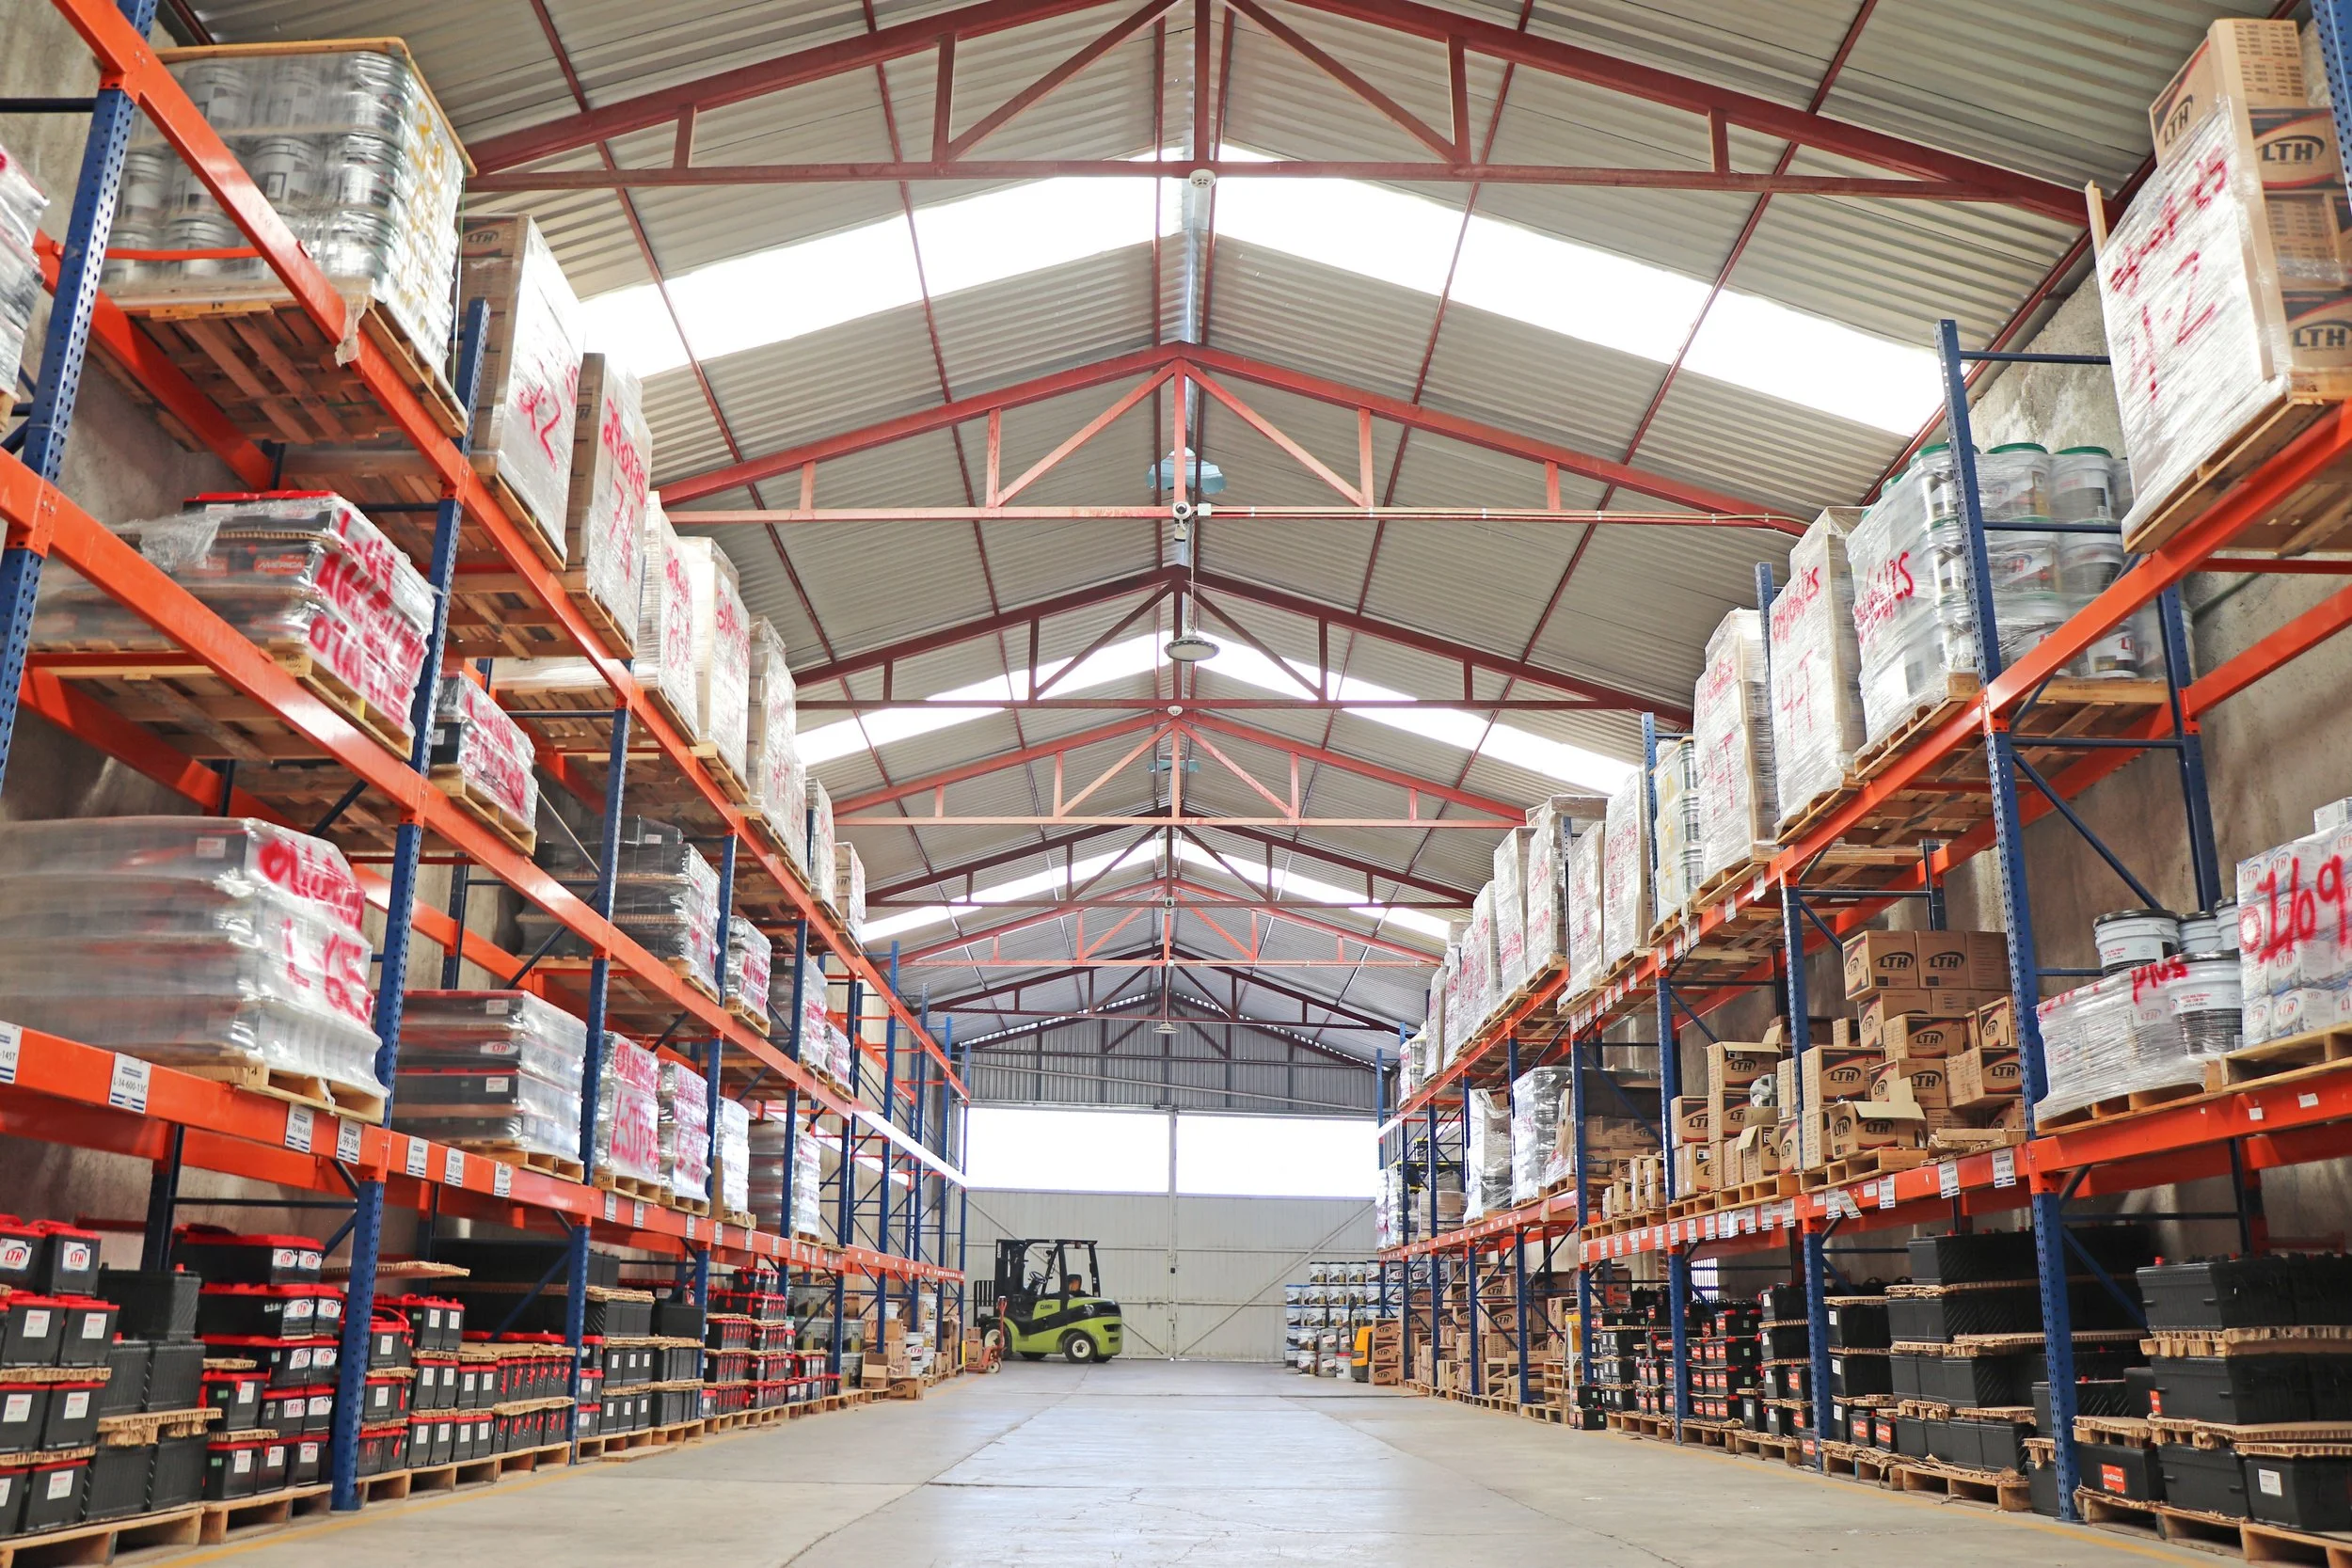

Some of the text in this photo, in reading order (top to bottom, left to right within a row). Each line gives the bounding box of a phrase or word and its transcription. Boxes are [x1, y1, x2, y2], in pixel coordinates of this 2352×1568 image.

[2164, 105, 2189, 146] LTH
[2262, 142, 2313, 161] LTH
[467, 234, 493, 244] LTH
[2292, 328, 2345, 347] LTH
[2270, 856, 2287, 870] LTH
[2243, 867, 2258, 882] LTH
[1880, 957, 1908, 968] LTH
[1930, 957, 1958, 968] LTH
[2276, 952, 2294, 968] LTH
[1847, 961, 1857, 975] LTH
[2140, 1010, 2159, 1021] LTH
[2249, 1008, 2264, 1022] LTH
[2278, 1002, 2295, 1016] LTH
[1862, 1019, 1872, 1033] LTH
[1985, 1023, 1996, 1037] LTH
[1915, 1034, 1940, 1044] LTH
[492, 1044, 509, 1053] LTH
[1731, 1060, 1753, 1071] LTH
[1992, 1065, 2015, 1076] LTH
[1830, 1069, 1855, 1082] LTH
[1912, 1074, 1936, 1087] LTH
[1874, 1083, 1885, 1096] LTH
[1835, 1121, 1848, 1137] LTH
[1866, 1119, 1890, 1132] LTH
[1782, 1144, 1792, 1156] LTH
[5, 1249, 23, 1262] LTH
[70, 1250, 85, 1263] LTH
[280, 1253, 291, 1263] LTH
[305, 1255, 315, 1265] LTH
[297, 1304, 308, 1313] LTH
[325, 1305, 335, 1314] LTH
[320, 1352, 330, 1362] LTH
